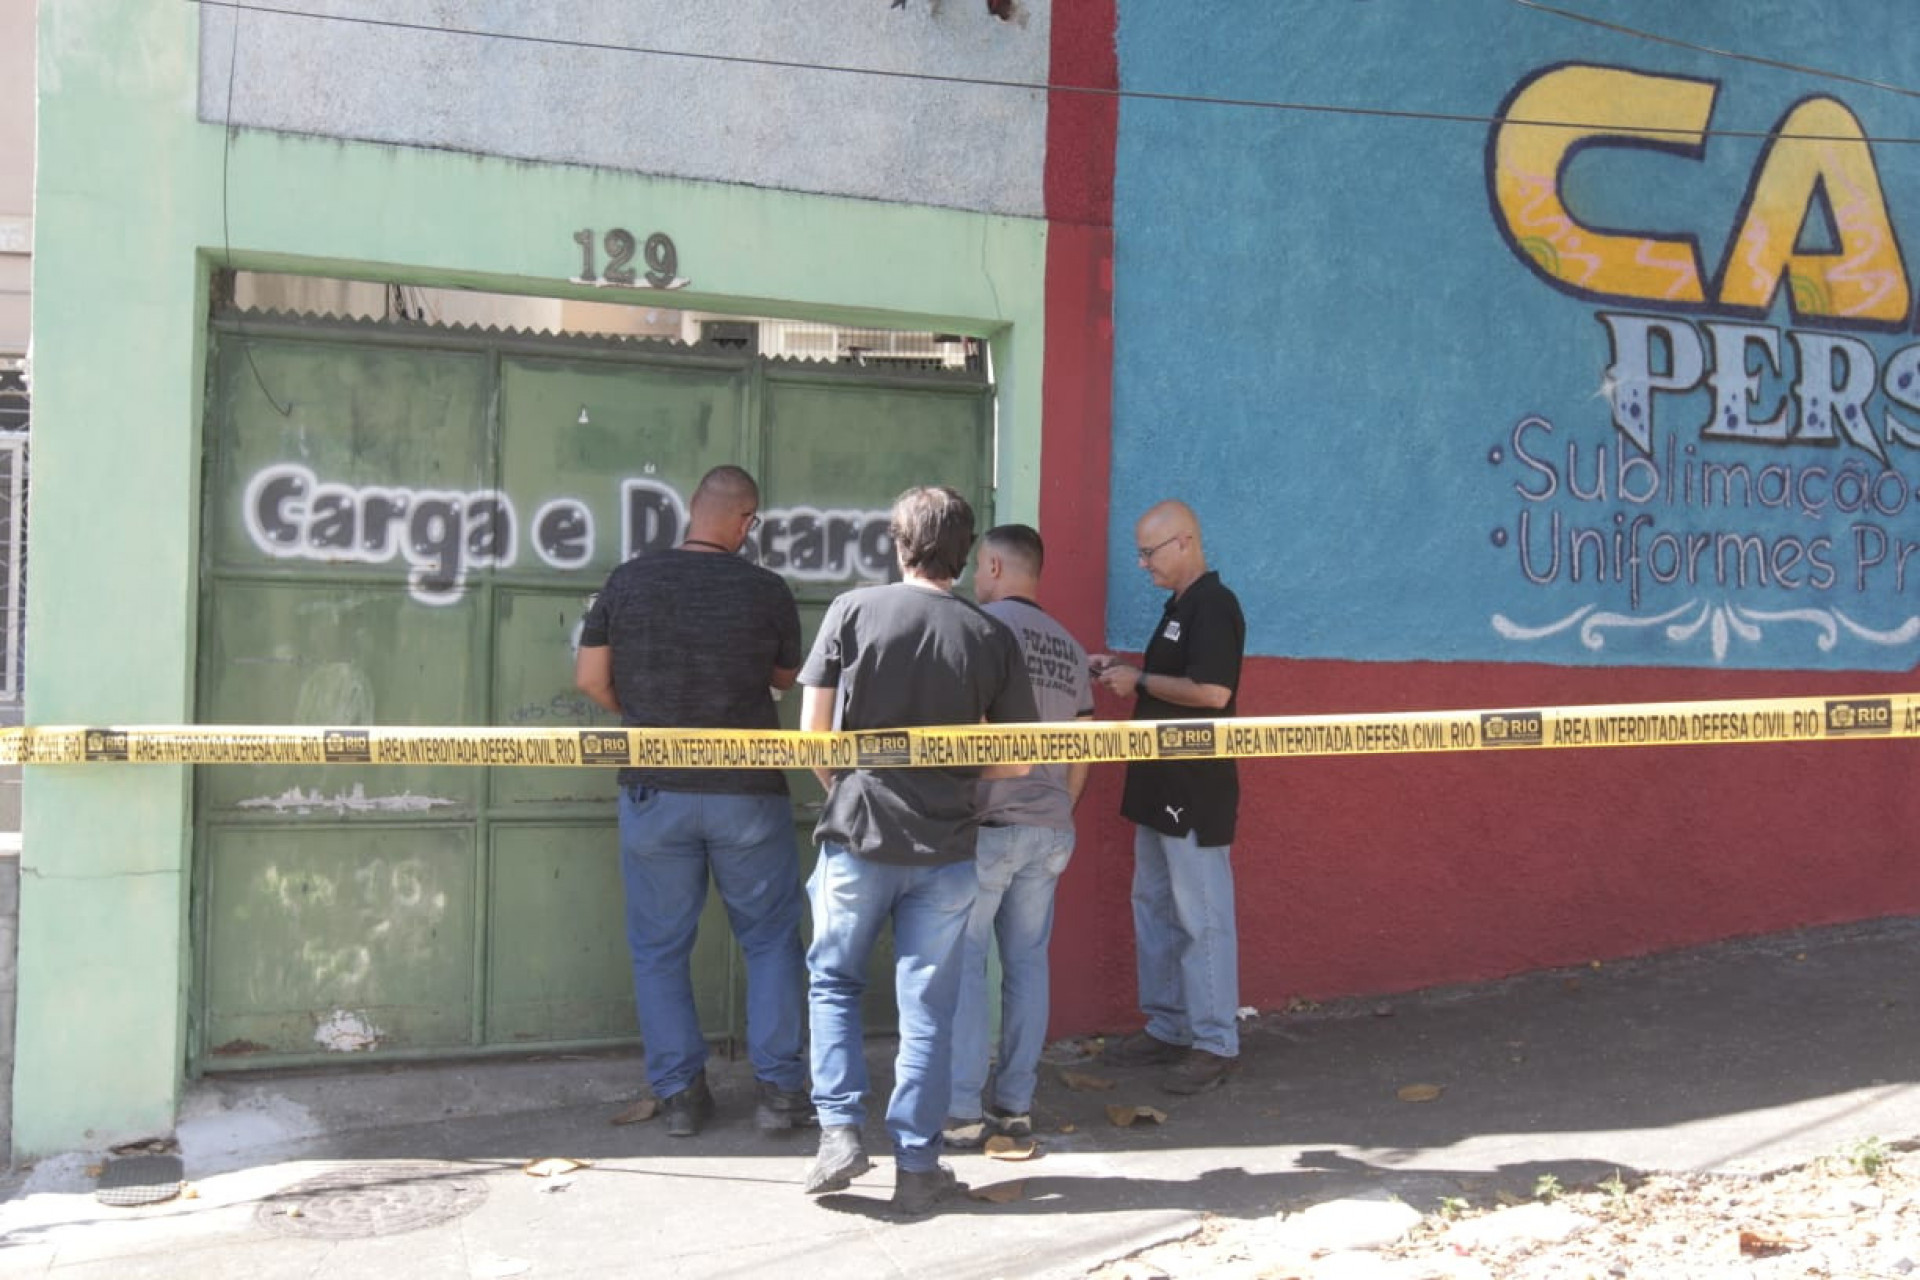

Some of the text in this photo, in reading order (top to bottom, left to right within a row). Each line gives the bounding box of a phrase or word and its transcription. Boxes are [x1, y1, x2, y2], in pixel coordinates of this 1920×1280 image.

[573, 228, 677, 289] 129
[1512, 414, 1909, 519] Sublimação
[245, 463, 517, 604] Carga
[533, 498, 595, 570] e
[1518, 509, 1837, 610] Uniformes
[1511, 719, 1538, 733] RIO
[1595, 715, 1687, 744] INTERDITADA
[1692, 713, 1748, 741] DEFESA
[1753, 710, 1789, 738] CIVIL
[1793, 709, 1819, 737] RIO
[1857, 707, 1888, 722] RIO
[408, 737, 478, 763] INTERDITADA
[480, 737, 523, 763] DEFESA
[526, 737, 555, 764] CIVIL
[556, 737, 576, 764] RIO
[603, 739, 626, 751] RIO
[883, 737, 906, 750] RIO
[956, 734, 1037, 763] INTERDITADA
[1041, 733, 1090, 762] DEFESA
[1095, 732, 1126, 759] CIVIL
[1129, 731, 1151, 758] RIO
[1185, 730, 1212, 743] RIO
[1265, 725, 1352, 754] INTERDITADA
[1356, 724, 1409, 751] DEFESA
[1413, 723, 1448, 749] CIVIL
[1450, 721, 1475, 748] RIO
[671, 739, 747, 766] INTERDITADA
[750, 739, 795, 766] DEFESA
[799, 739, 828, 765] CIVIL
[831, 738, 851, 765] RIO
